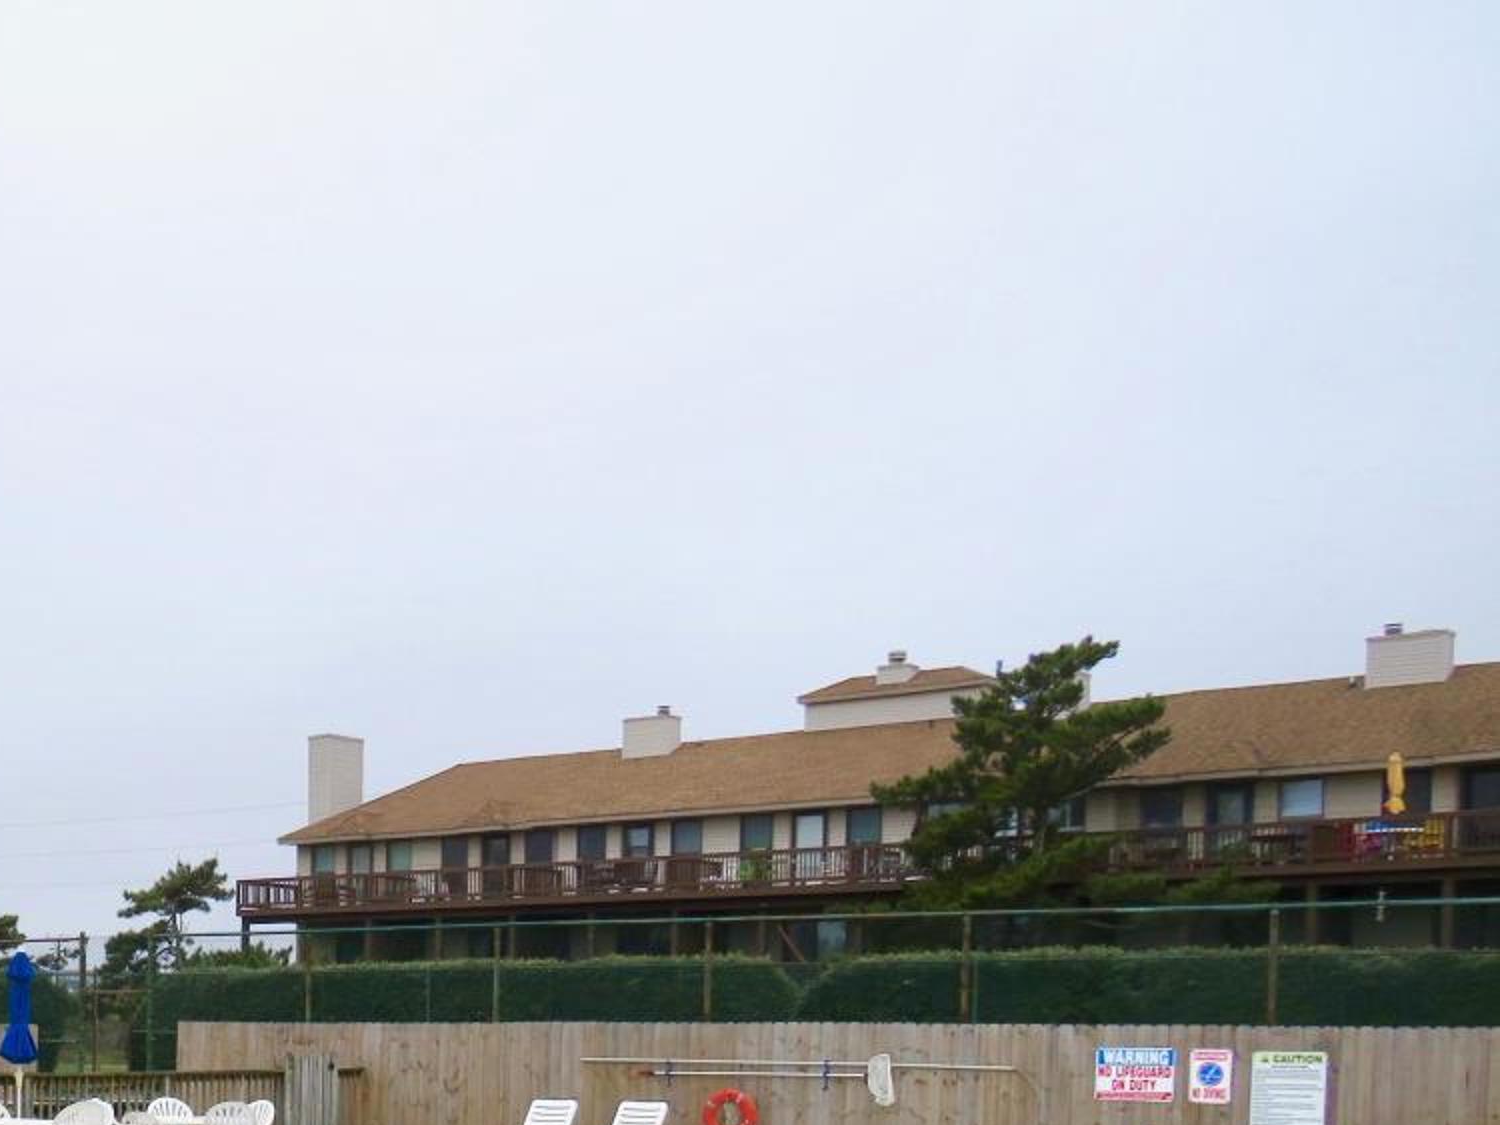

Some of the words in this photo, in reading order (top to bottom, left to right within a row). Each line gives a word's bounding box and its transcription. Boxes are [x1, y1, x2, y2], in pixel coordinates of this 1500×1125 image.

[1103, 1050, 1168, 1065] WARNING
[1272, 1054, 1323, 1065] CAUTION
[1097, 1066, 1111, 1077] NO
[1115, 1066, 1172, 1079] LIFEGUARD
[1112, 1079, 1125, 1091] ON
[1130, 1079, 1157, 1091] DUTY
